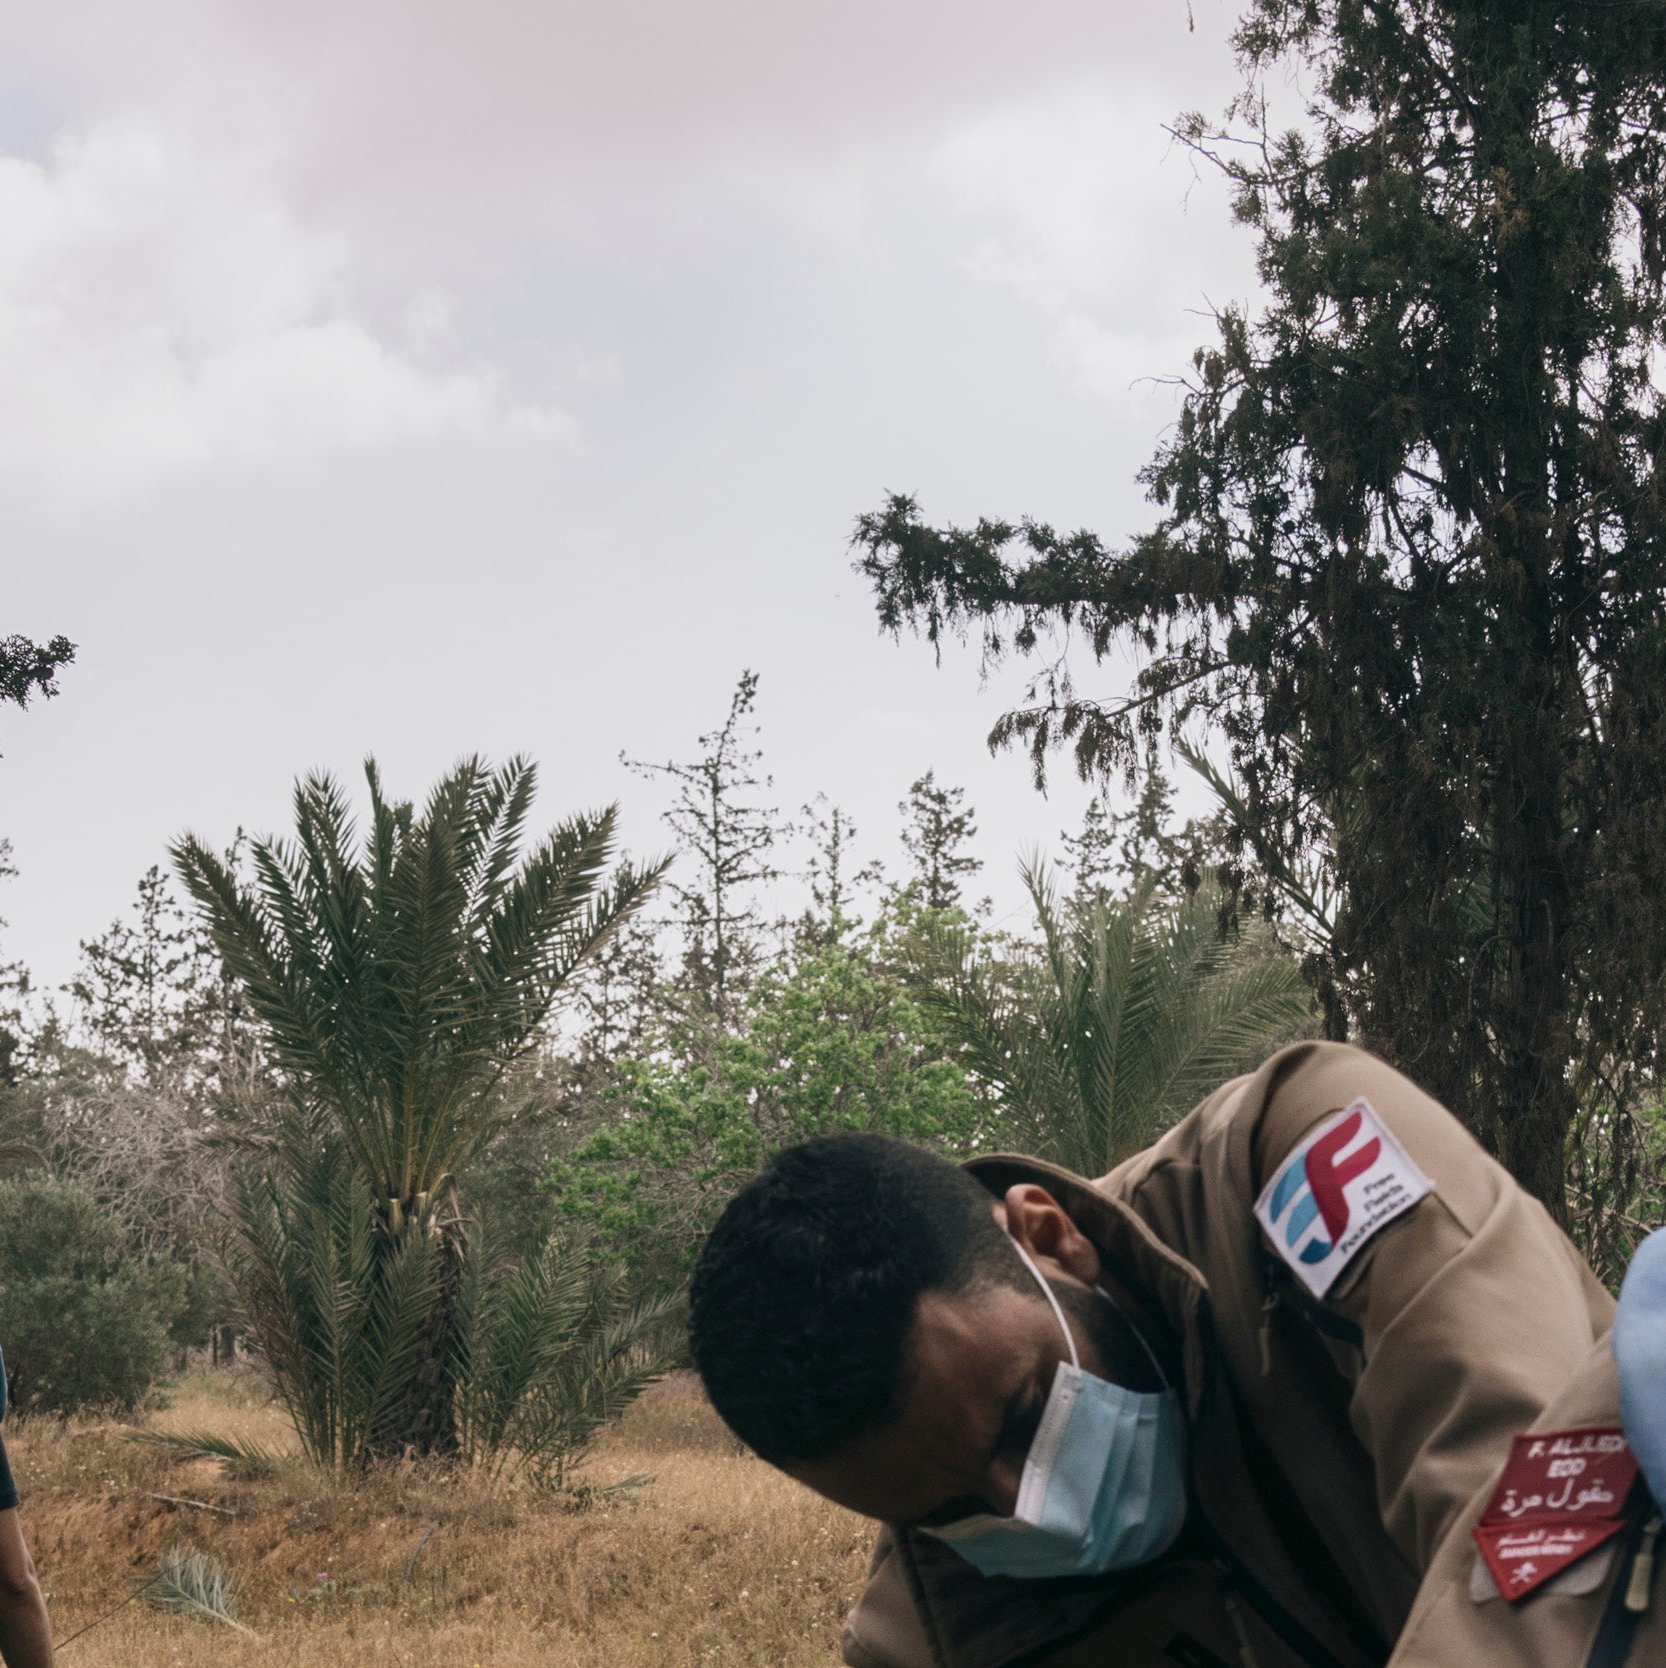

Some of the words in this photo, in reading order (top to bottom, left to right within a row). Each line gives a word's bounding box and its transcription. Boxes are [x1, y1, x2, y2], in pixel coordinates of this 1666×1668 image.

[1363, 1172, 1396, 1195] Free
[1363, 1182, 1405, 1213] Fields
[1340, 1192, 1414, 1255] Foundation
